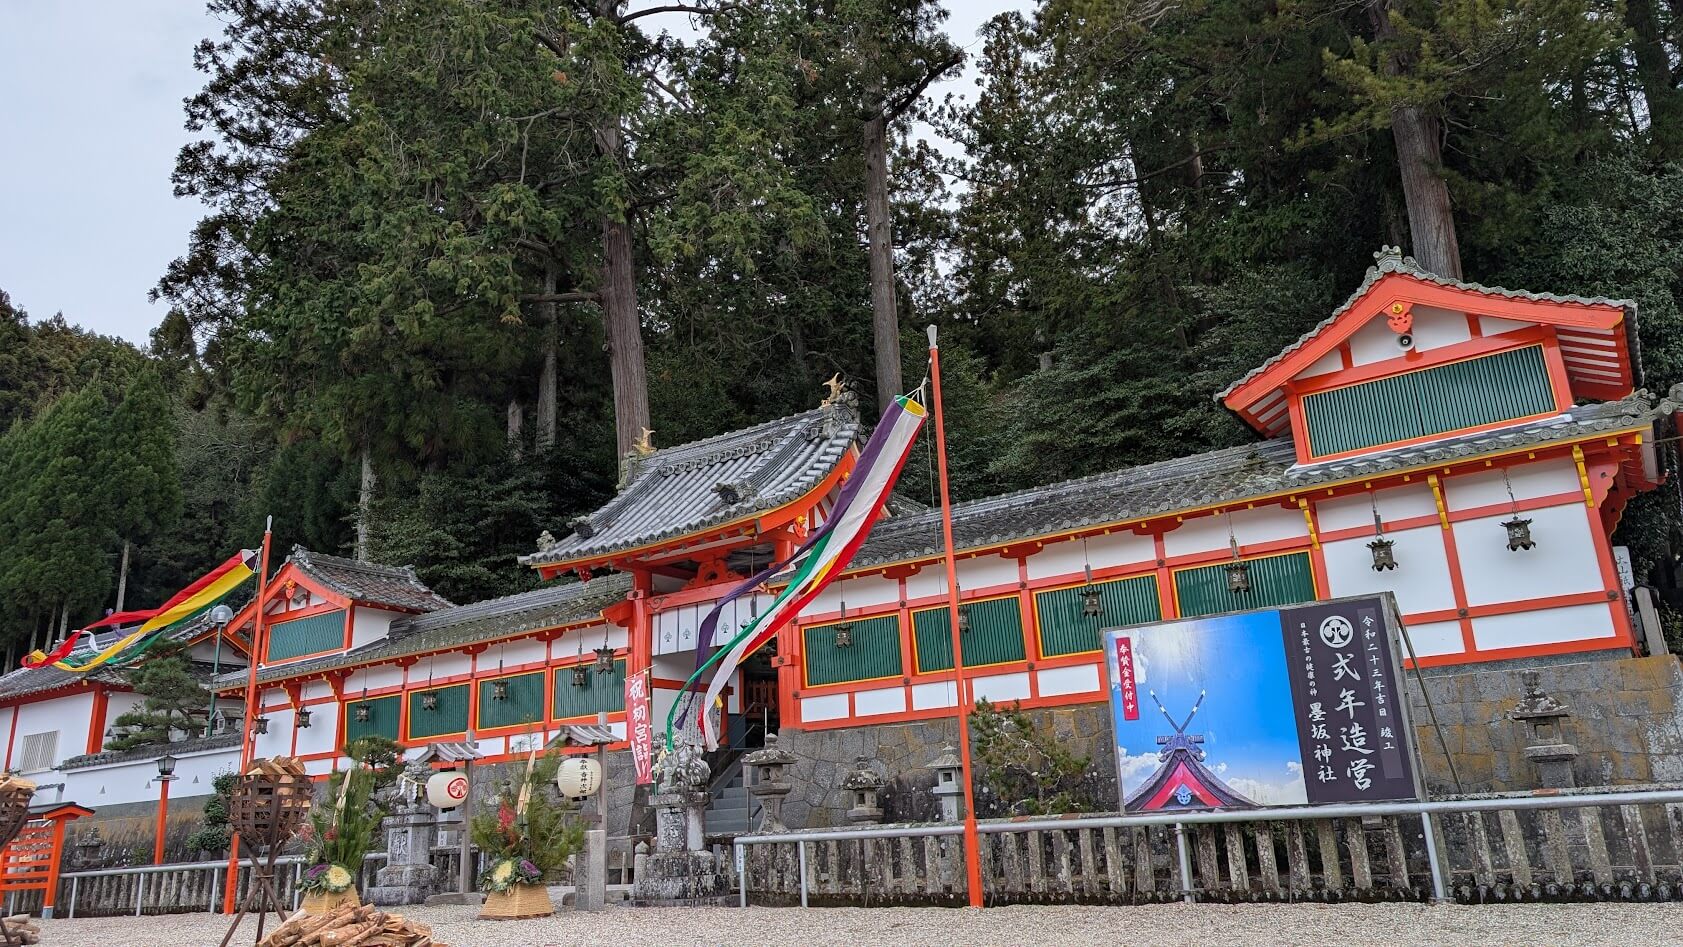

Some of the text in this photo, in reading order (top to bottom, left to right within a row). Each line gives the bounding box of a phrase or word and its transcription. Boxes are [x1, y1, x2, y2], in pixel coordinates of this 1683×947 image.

[1120, 644, 1135, 713] 奉賛金受付中
[1300, 622, 1337, 783] 日本最古の健康の神 墨坂神社
[1331, 653, 1375, 791] 式年造営
[1362, 615, 1395, 750] 令和二十三年吉日 竣工
